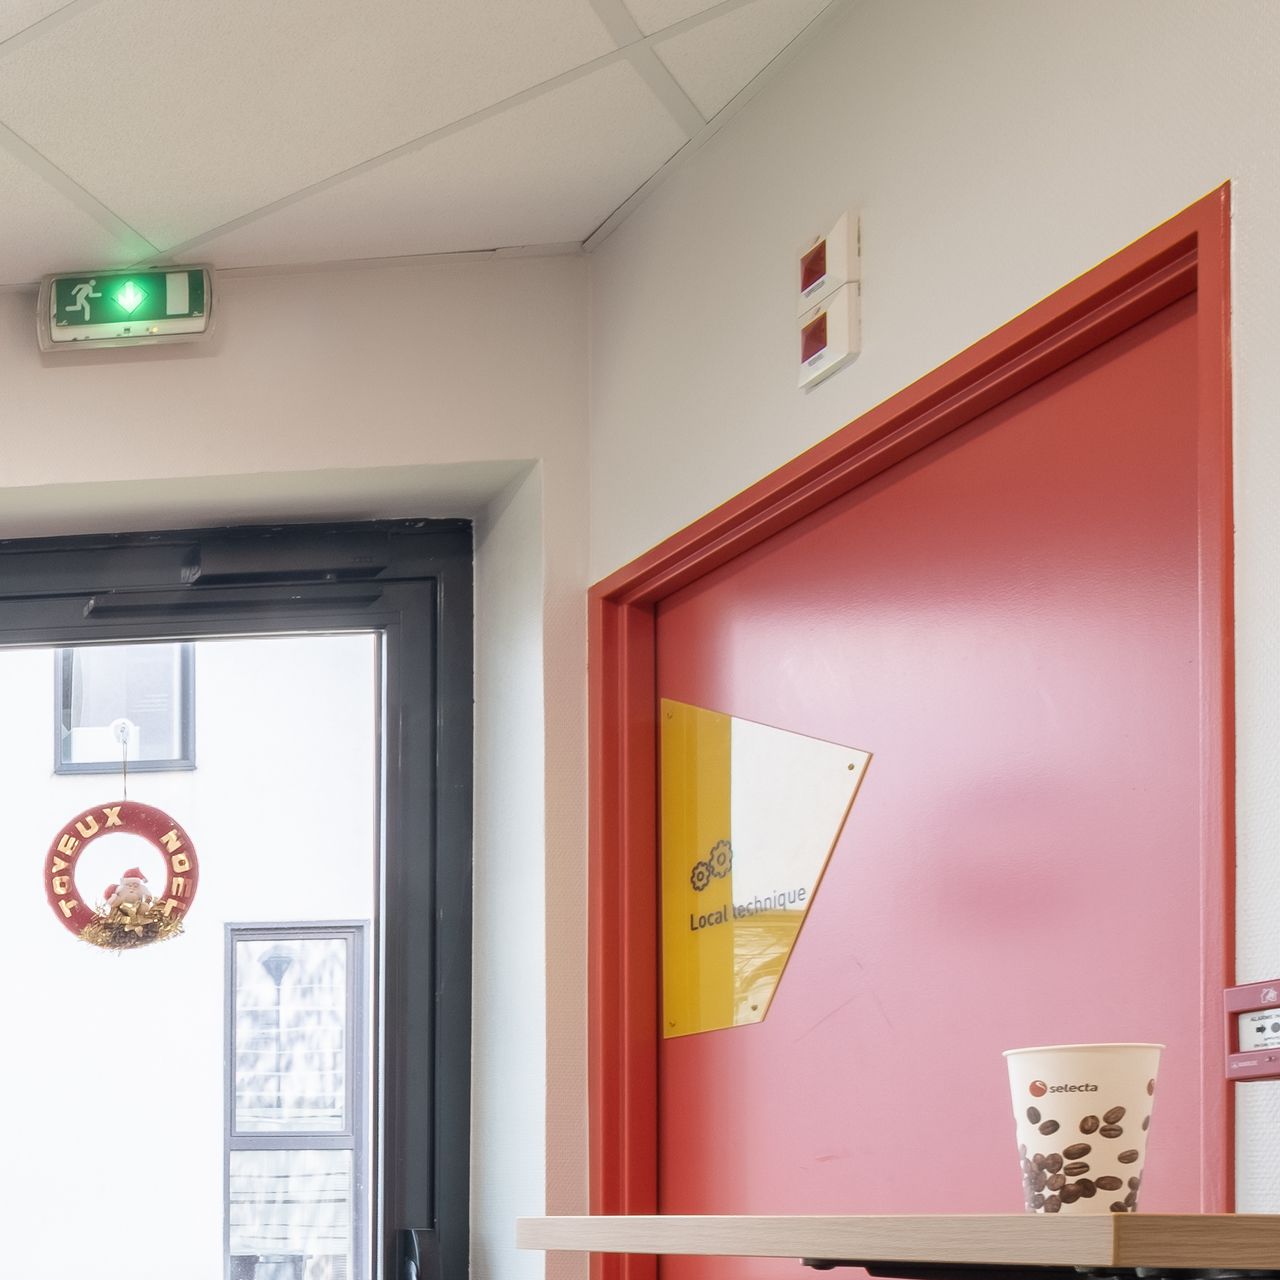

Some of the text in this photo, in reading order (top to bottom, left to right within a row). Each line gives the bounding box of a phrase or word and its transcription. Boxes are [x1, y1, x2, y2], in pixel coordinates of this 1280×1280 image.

[690, 886, 807, 932] Local technique
[1049, 1083, 1098, 1094] selecta
